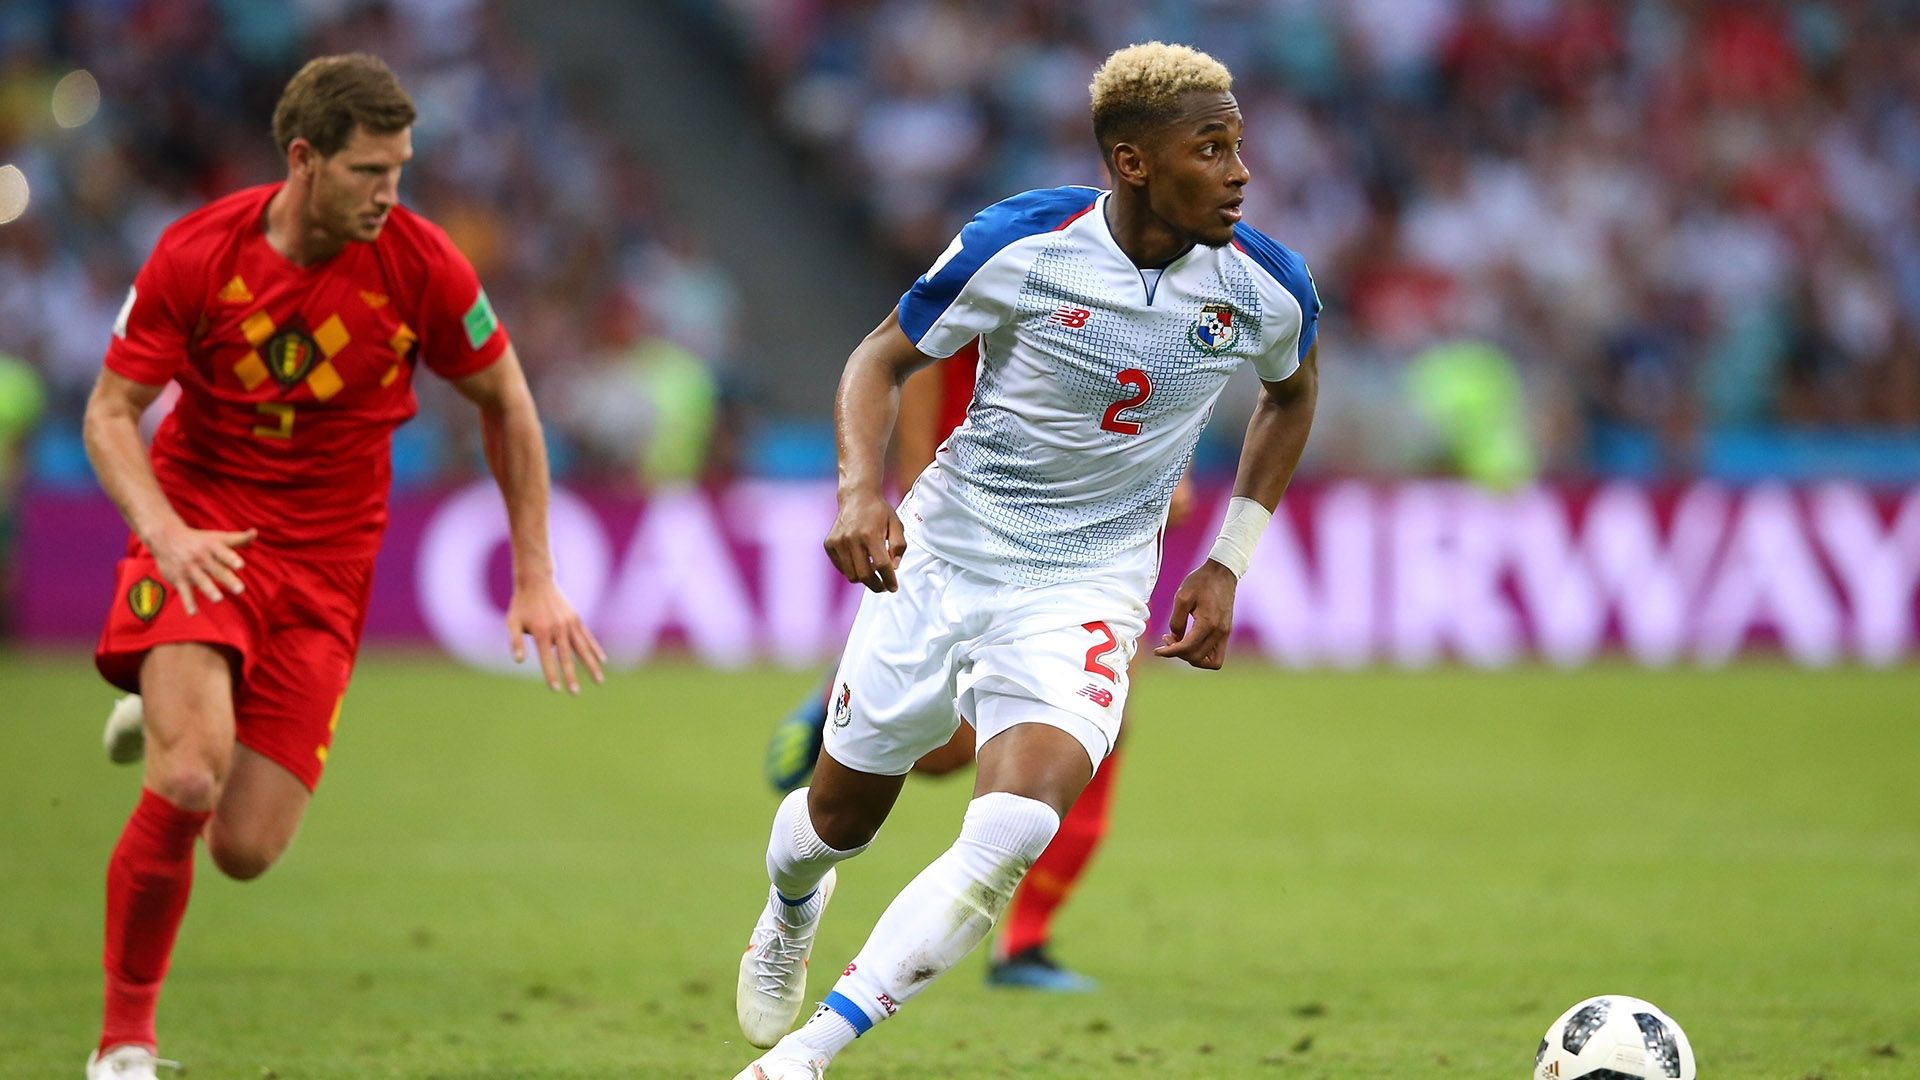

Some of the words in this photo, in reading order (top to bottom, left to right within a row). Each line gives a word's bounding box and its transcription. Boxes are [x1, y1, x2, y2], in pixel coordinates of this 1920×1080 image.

[1101, 368, 1155, 435] 2
[416, 478, 850, 672] QAT
[1081, 620, 1120, 685] 2
